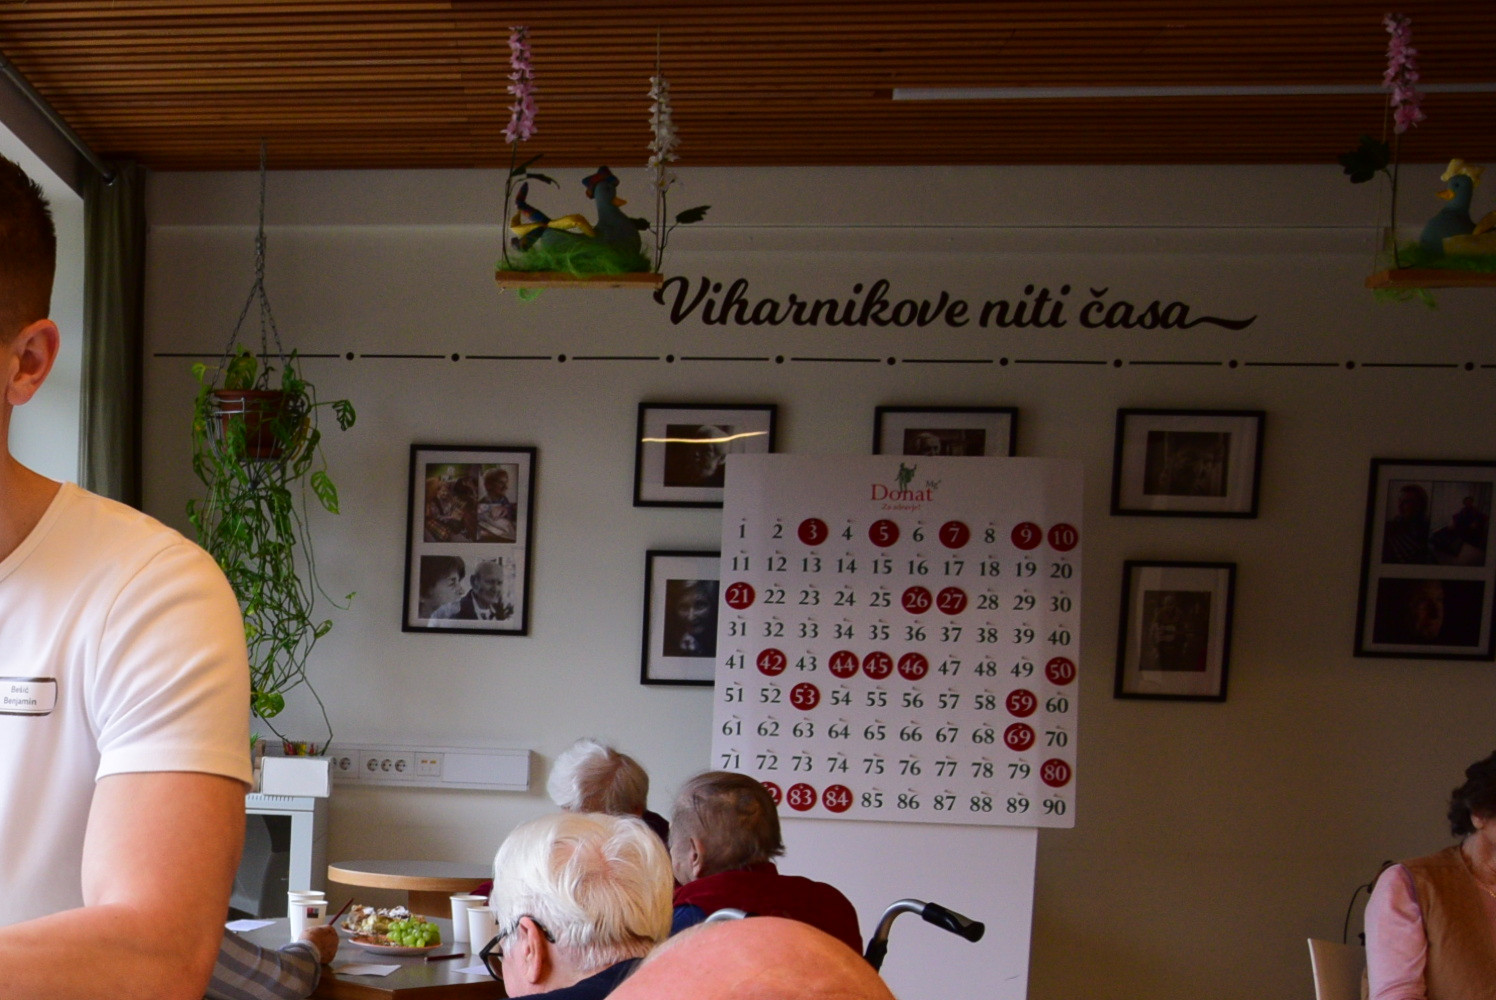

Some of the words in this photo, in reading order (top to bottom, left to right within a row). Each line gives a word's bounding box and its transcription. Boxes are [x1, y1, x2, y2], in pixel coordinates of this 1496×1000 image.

[653, 276, 970, 328] Viharnikove
[979, 284, 1071, 328] niti
[1079, 287, 1257, 331] časa
[871, 484, 933, 502] Donat
[739, 524, 745, 538] 1
[771, 524, 783, 538] 2
[809, 526, 817, 539] 3
[841, 526, 853, 540] 4
[880, 527, 888, 541] 5
[912, 528, 925, 542] 6
[950, 528, 958, 542] 7
[983, 529, 996, 543] 8
[1022, 530, 1031, 544] 9
[1054, 530, 1074, 545] 10
[732, 557, 749, 570] 11
[767, 557, 787, 571] 12
[802, 558, 822, 572] 13
[837, 559, 857, 573] 14
[873, 560, 893, 574] 15
[909, 560, 929, 575] 16
[944, 561, 965, 576] 17
[980, 562, 1001, 576] 18
[1016, 562, 1037, 576] 19
[1049, 563, 1073, 578] 20
[729, 589, 748, 603] 21
[763, 589, 786, 604] 22
[798, 590, 821, 605] 23
[833, 591, 857, 606] 24
[869, 592, 891, 607] 25
[906, 594, 928, 608] 26
[941, 594, 962, 609] 27
[976, 594, 999, 610] 28
[1012, 595, 1037, 610] 29
[1050, 596, 1073, 612] 30
[728, 622, 746, 636] 31
[763, 622, 785, 637] 32
[798, 623, 819, 638] 33
[834, 624, 855, 639] 34
[868, 625, 890, 640] 35
[904, 626, 927, 641] 36
[941, 627, 963, 642] 37
[976, 628, 999, 643] 38
[1012, 629, 1035, 643] 39
[1047, 631, 1071, 645] 40
[725, 655, 745, 668] 41
[761, 655, 782, 669] 42
[795, 656, 817, 671] 43
[833, 657, 855, 672] 44
[866, 658, 888, 673] 45
[902, 659, 924, 674] 46
[937, 661, 961, 675] 47
[973, 662, 997, 676] 48
[1010, 662, 1034, 677] 49
[1050, 664, 1072, 679] 50
[4, 696, 37, 706] Benjamin
[725, 688, 743, 702] 51
[760, 688, 782, 703] 52
[795, 690, 815, 704] 53
[831, 691, 852, 705] 54
[866, 692, 887, 706] 55
[903, 693, 924, 708] 56
[938, 694, 960, 709] 57
[974, 695, 996, 710] 58
[1011, 696, 1032, 711] 59
[1045, 698, 1069, 713] 60
[721, 721, 741, 735] 61
[757, 722, 780, 736] 62
[792, 723, 815, 737] 63
[827, 724, 851, 739] 64
[863, 726, 886, 740] 65
[899, 727, 923, 741] 66
[935, 728, 959, 742] 67
[971, 729, 995, 743] 68
[1007, 730, 1030, 745] 69
[1045, 731, 1069, 746] 70
[721, 754, 740, 768] 71
[756, 755, 778, 770] 72
[791, 756, 813, 771] 73
[827, 758, 849, 772] 74
[863, 759, 885, 774] 75
[899, 760, 922, 775] 76
[935, 761, 958, 776] 77
[971, 762, 994, 778] 78
[1007, 764, 1031, 778] 79
[1045, 765, 1067, 781] 80
[790, 790, 812, 804] 83
[825, 792, 849, 806] 84
[861, 793, 883, 808] 85
[897, 794, 921, 809] 86
[933, 796, 957, 810] 87
[969, 797, 993, 812] 88
[1006, 798, 1030, 813] 89
[1042, 800, 1067, 815] 90
